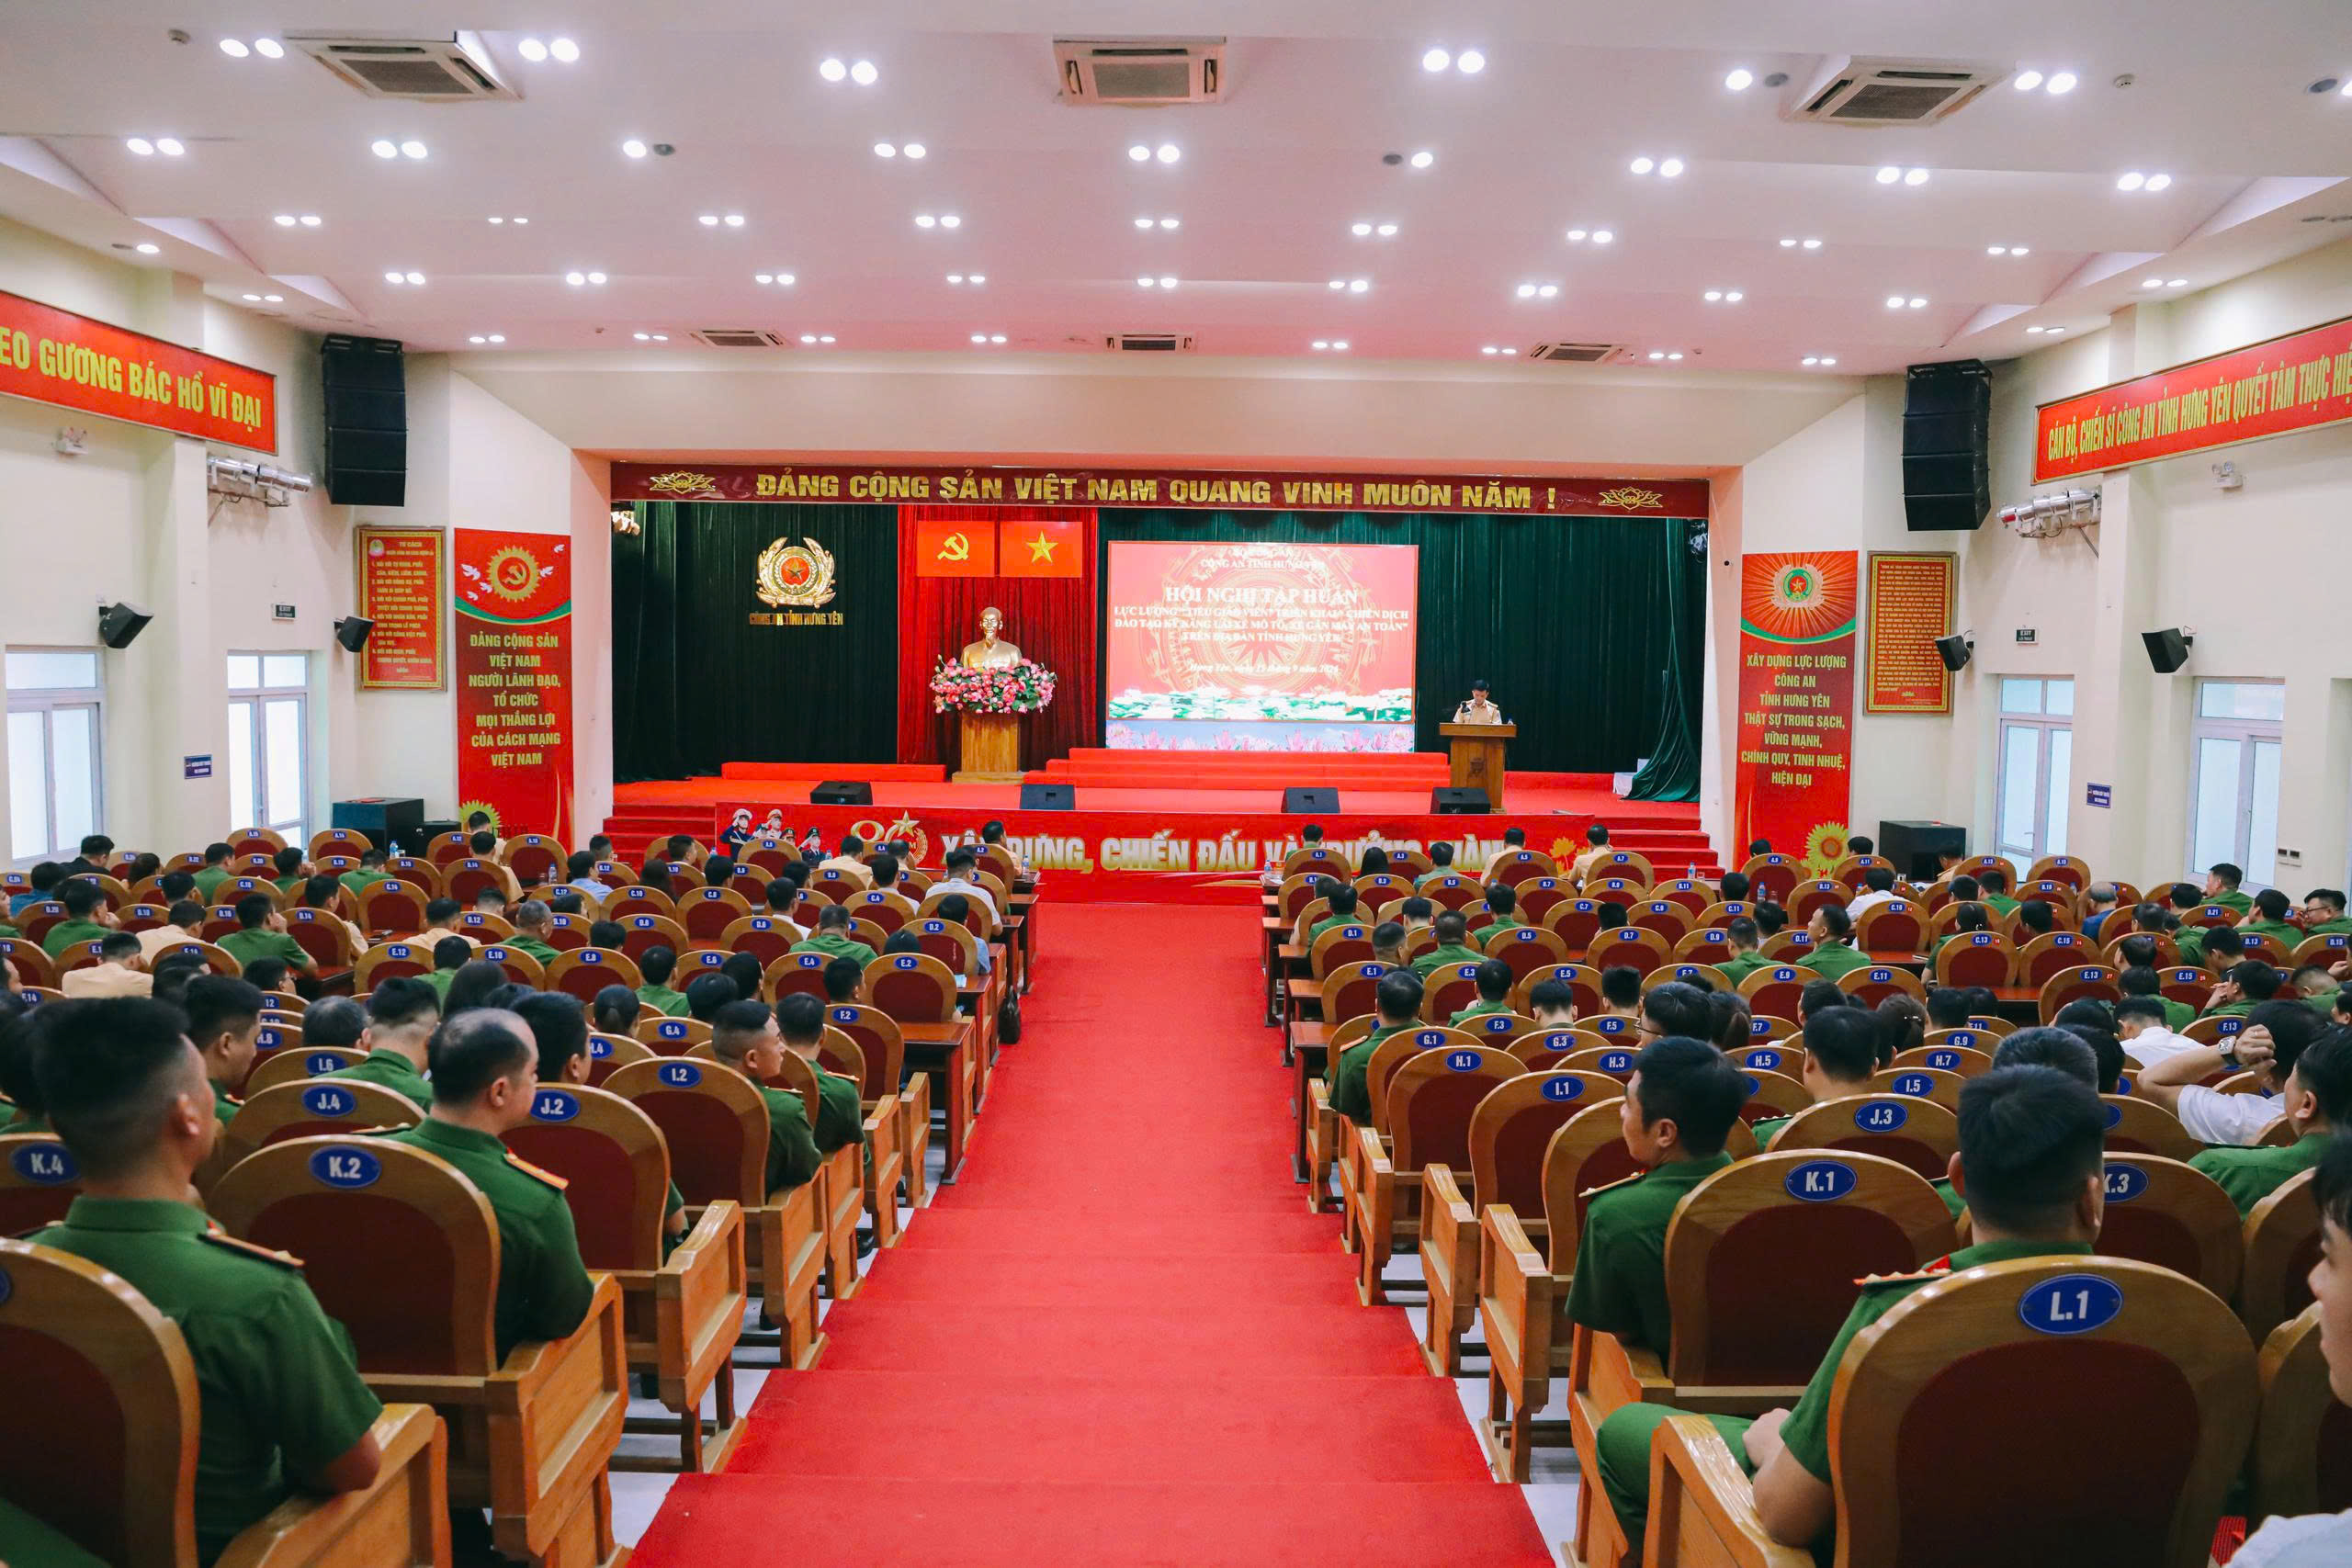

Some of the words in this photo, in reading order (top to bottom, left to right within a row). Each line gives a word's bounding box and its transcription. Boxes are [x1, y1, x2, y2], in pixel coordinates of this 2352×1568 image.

[39, 338, 123, 393] GƯƠNG
[129, 360, 172, 404] BÁC
[177, 371, 204, 412] HỒ
[209, 382, 227, 419] VĨ
[232, 392, 261, 433] ĐẠI
[2048, 421, 2064, 461] CÁN
[2064, 417, 2078, 464] BỘ,
[2080, 405, 2104, 455] CHIẾN
[2106, 406, 2116, 449] SĨ
[2116, 401, 2140, 446] CÔNG
[2141, 405, 2155, 441] AN
[2157, 386, 2179, 437] TỈNH
[2180, 388, 2209, 432] HƯNG
[2211, 377, 2233, 424] YÊN
[2233, 361, 2268, 423] QUYẾT
[2270, 360, 2296, 412] TÂM
[2298, 354, 2331, 411] THỰC
[756, 467, 839, 497] ĐẢNG
[850, 470, 930, 502] CỘNG
[940, 468, 1002, 500] SẢN
[1014, 473, 1078, 504] VIỆT
[1088, 479, 1158, 501] NAM
[1169, 480, 1271, 503] QUANG
[1283, 481, 1353, 505] VINH
[1363, 479, 1452, 507] MUÔN
[1462, 480, 1532, 509] NĂM
[1165, 584, 1202, 606] HỘI
[1114, 606, 1136, 618] LỰC
[1382, 610, 1408, 623] DỊCH
[1138, 619, 1162, 629] TẠO
[470, 631, 500, 647] ĐẢNG
[504, 633, 533, 649] CỘNG
[537, 632, 559, 647] SẢN
[490, 652, 512, 670] VIỆT
[515, 655, 540, 667] NAM
[1747, 652, 1765, 667] XÂY
[1767, 654, 1792, 670] DỰNG
[1794, 655, 1813, 670] LỰC
[1815, 655, 1847, 671] LƯỢNG
[469, 671, 503, 687] NGƯỜI
[506, 672, 534, 687] LÃNH
[537, 674, 561, 689] ĐẠO,
[1774, 672, 1800, 687] CÔNG
[1803, 675, 1816, 687] AN
[493, 690, 507, 706] TỔ
[510, 692, 538, 705] CHỨC
[1759, 690, 1781, 706] TỈNH
[1783, 694, 1809, 707] HƯNG
[1812, 693, 1830, 708] YÊN
[476, 715, 497, 729] MỌI
[501, 710, 536, 727] THẮNG
[539, 713, 555, 728] LỢI
[1745, 711, 1767, 728] THẬT
[1769, 713, 1782, 728] SỰ
[1783, 714, 1815, 727] TRONG
[1816, 715, 1845, 730] SẠCH,
[471, 730, 494, 747] CỦA
[497, 732, 526, 746] CÁCH
[529, 733, 560, 748] MẠNG
[1764, 731, 1789, 746] VỮNG
[1792, 734, 1823, 749] MẠNH,
[492, 751, 514, 768] VIỆT
[517, 753, 542, 765] NAM
[1741, 749, 1770, 764] CHÍNH
[1771, 752, 1791, 766] QUY,
[1793, 754, 1815, 766] TINH
[1817, 753, 1846, 772] NHUỆ,
[1771, 771, 1793, 786] HIỆN
[1101, 829, 1190, 871] CHIẾN
[1197, 829, 1258, 871] ĐẤU
[488, 950, 503, 960] E.10
[1367, 966, 1377, 976] E.1
[841, 1010, 851, 1020] F.2
[666, 1025, 680, 1035] G.4
[1495, 1021, 1504, 1029] F.3
[1607, 1021, 1617, 1030] F.5
[1752, 1022, 1763, 1032] F.7
[2223, 1022, 2236, 1031] F.13
[1424, 1034, 1437, 1045] G.1
[1553, 1036, 1567, 1047] G.3
[1953, 1035, 1968, 1046] G.9
[319, 1058, 334, 1072] I.6
[1456, 1055, 1470, 1066] H.1
[1610, 1056, 1625, 1068] H.3
[1756, 1055, 1770, 1066] H.5
[1935, 1055, 1951, 1066] H.7
[672, 1068, 687, 1081] I.2
[1555, 1082, 1568, 1095] I.1
[1905, 1079, 1921, 1092] I.5
[318, 1094, 340, 1110] J.4
[541, 1099, 563, 1114] J.2
[1871, 1109, 1892, 1124] J.3
[31, 1154, 63, 1174] K.4
[330, 1156, 361, 1179] K.2
[1806, 1171, 1834, 1191] K.1
[2051, 1291, 2088, 1320] L.1
